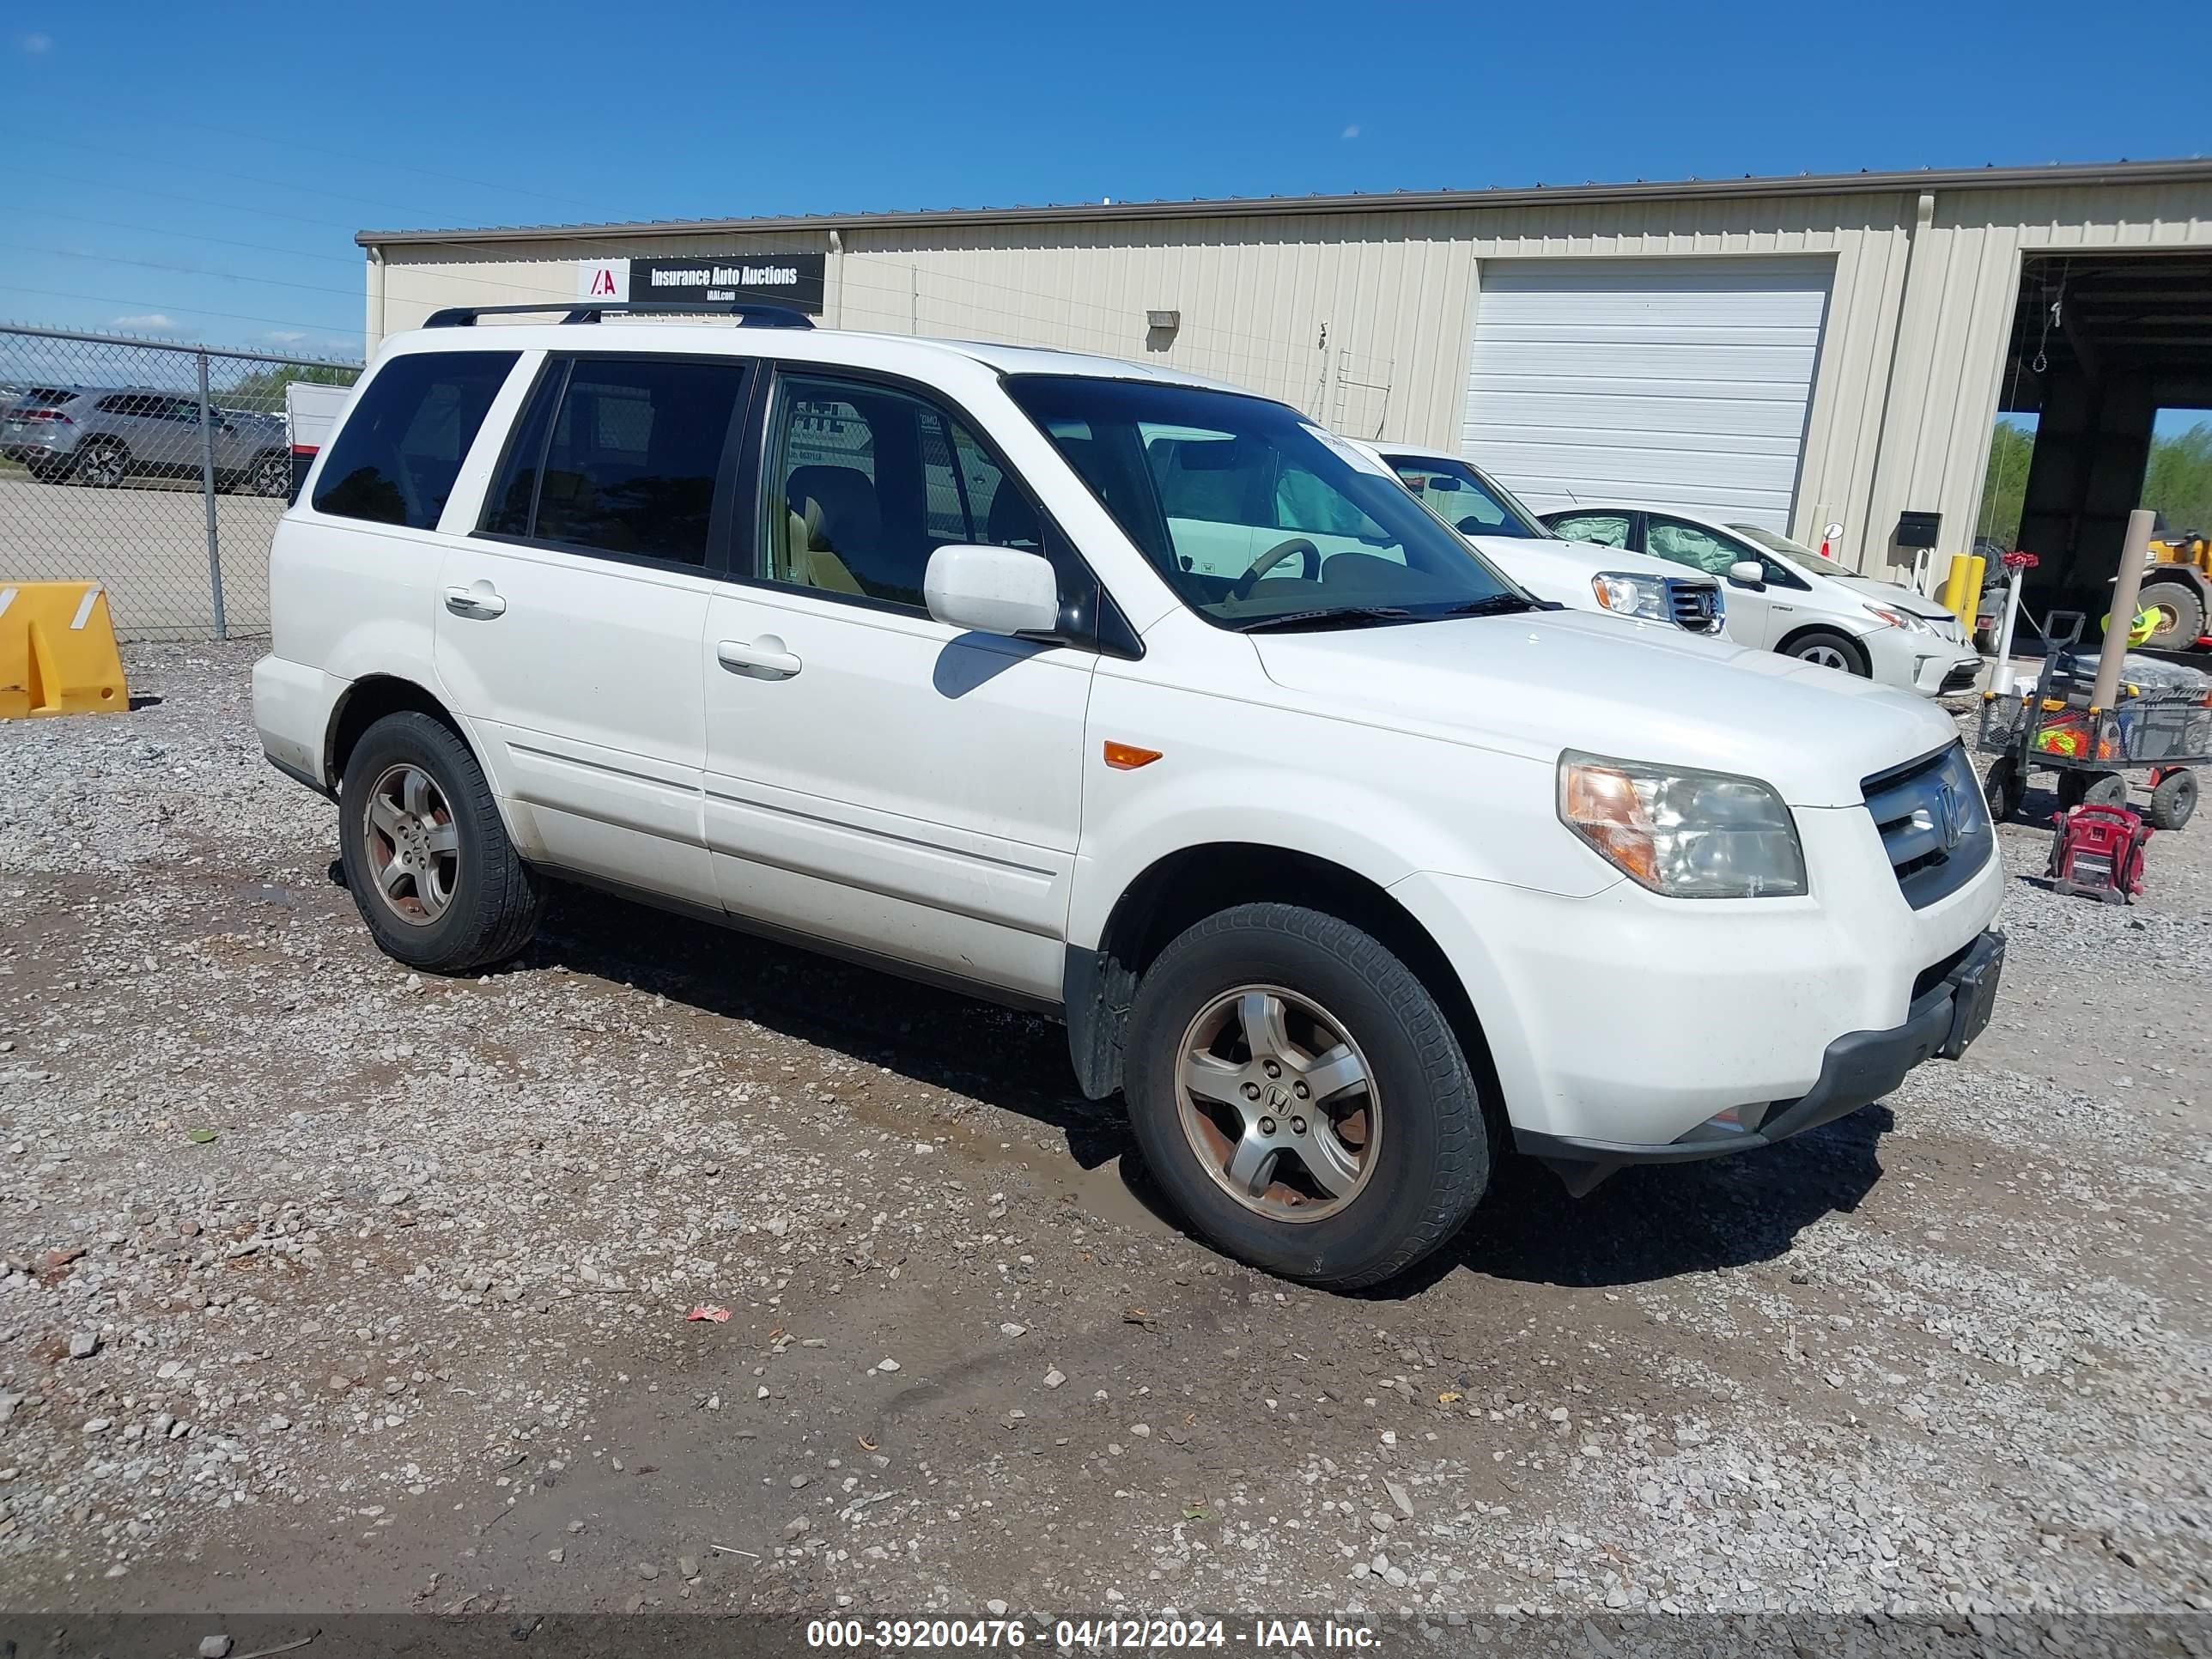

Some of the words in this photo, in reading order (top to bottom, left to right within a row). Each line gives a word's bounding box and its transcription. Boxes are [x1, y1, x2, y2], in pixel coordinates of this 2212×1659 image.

[651, 268, 710, 286] Insurance
[712, 266, 740, 285] Auto
[741, 265, 797, 285] Auctions
[707, 289, 736, 301] IAAI.com
